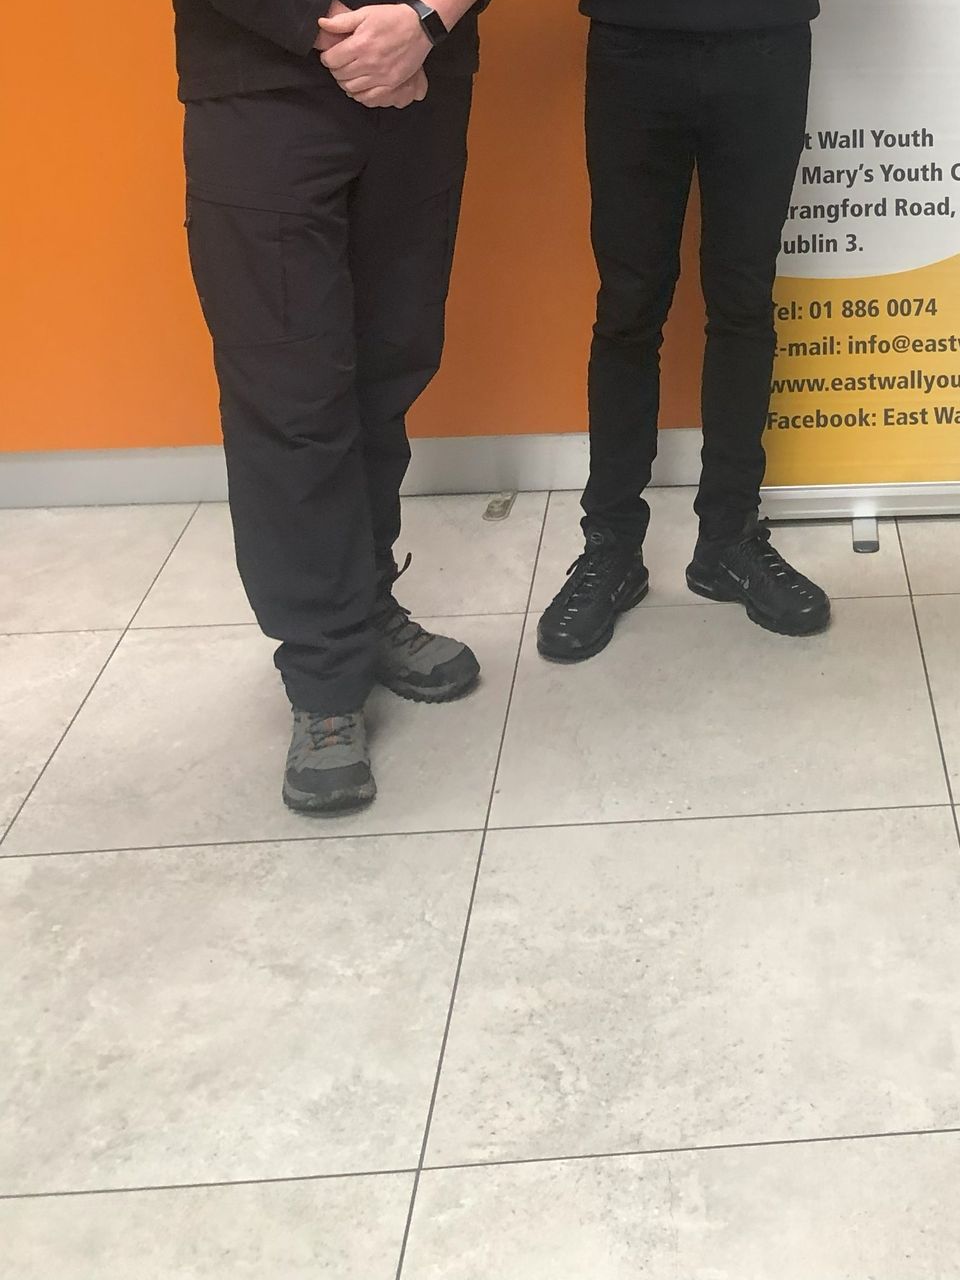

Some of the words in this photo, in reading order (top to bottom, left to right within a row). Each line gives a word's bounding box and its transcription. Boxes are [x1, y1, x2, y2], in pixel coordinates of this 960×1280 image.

[818, 129, 864, 149] Wall
[871, 128, 934, 148] Youth
[802, 163, 874, 188] Mary’s
[879, 163, 943, 183] Youth
[786, 198, 887, 223] rangford
[895, 197, 956, 218] Road,
[783, 234, 838, 254] ublin
[845, 233, 864, 252] 3.
[773, 301, 803, 320] el:
[809, 300, 832, 319] 01
[842, 299, 880, 318] 886
[887, 298, 938, 318] 0074
[774, 336, 841, 357] -mail:
[767, 408, 877, 430] Facebook:
[883, 407, 929, 426] East
